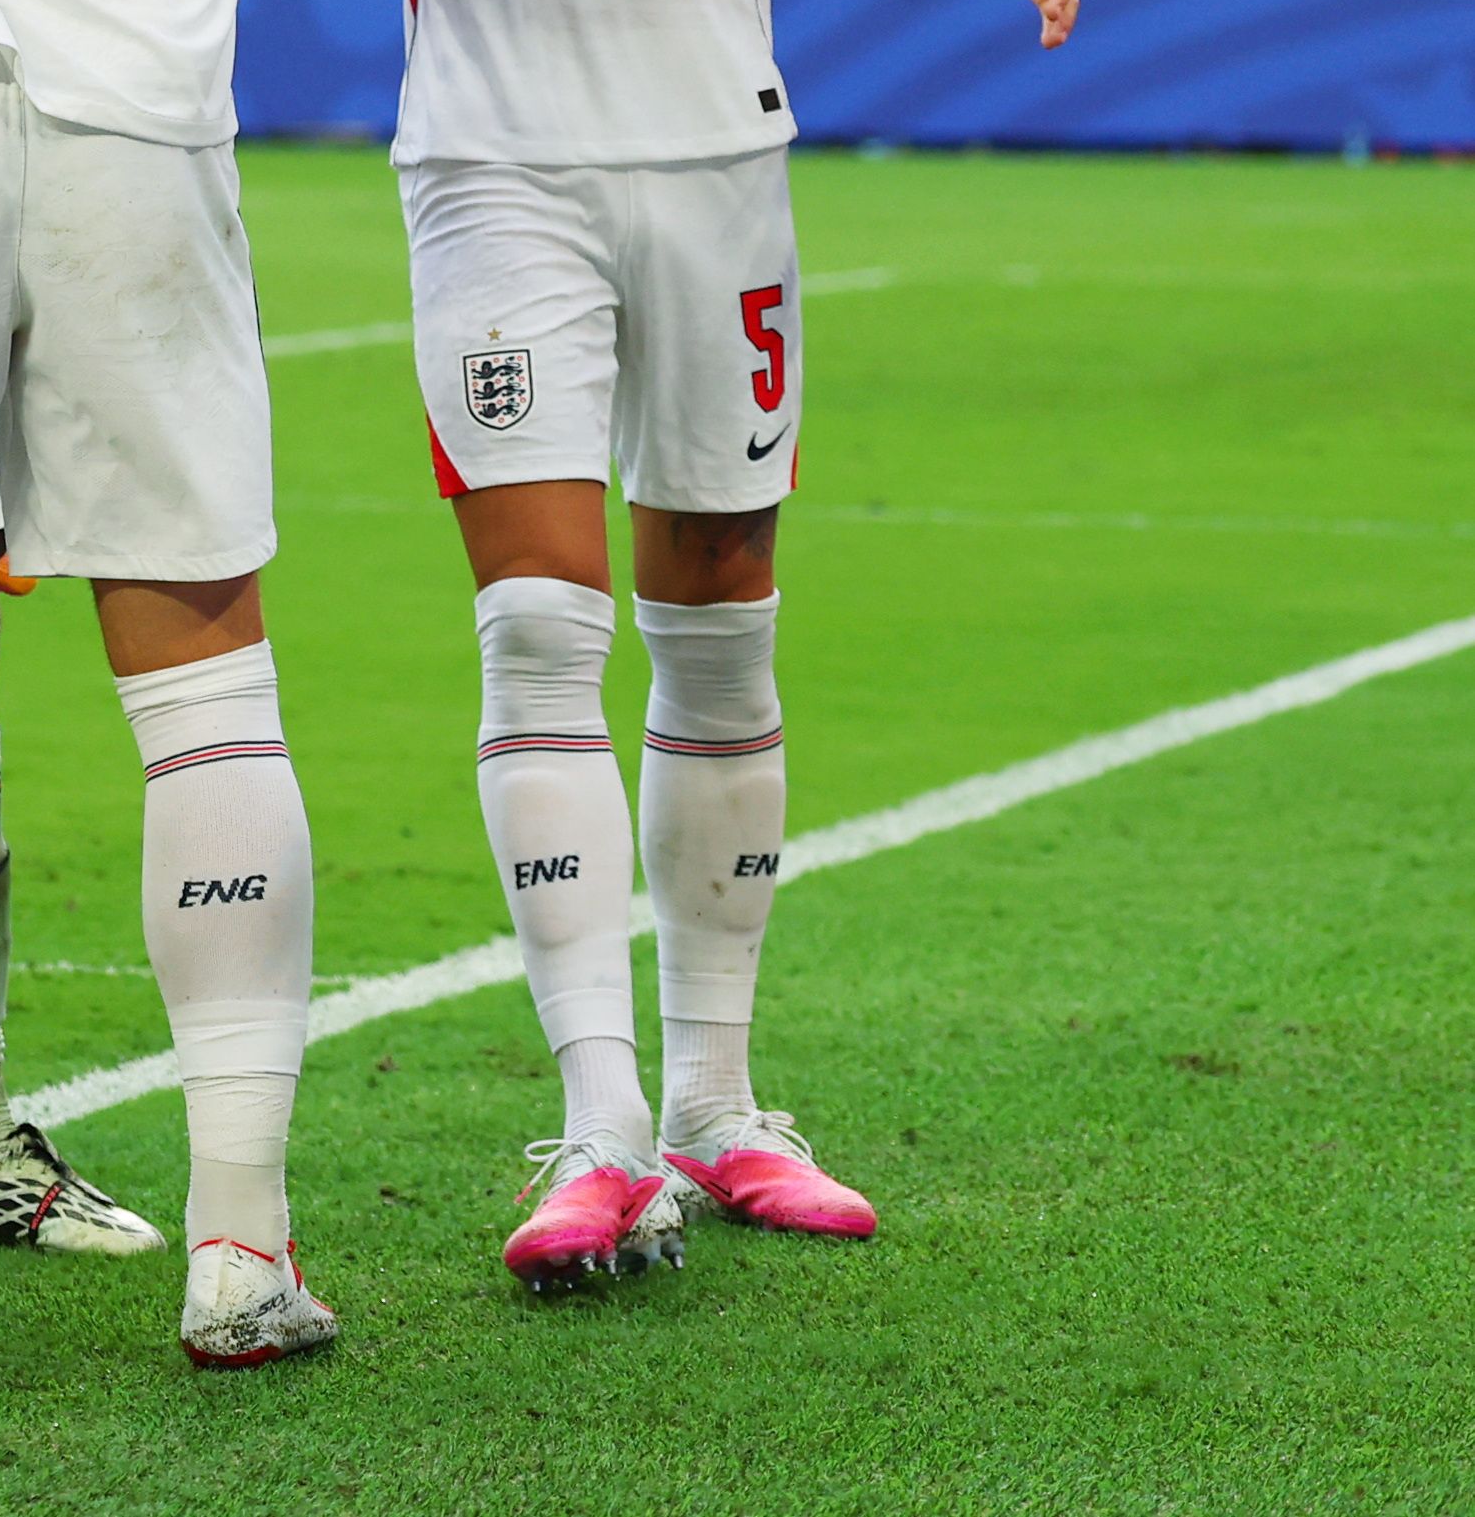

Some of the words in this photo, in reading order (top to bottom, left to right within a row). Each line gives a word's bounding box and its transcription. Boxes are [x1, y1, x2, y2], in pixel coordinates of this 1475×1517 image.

[739, 283, 786, 413] 5
[515, 855, 580, 891] ENG
[734, 853, 779, 878] EN
[178, 874, 268, 909] ENG
